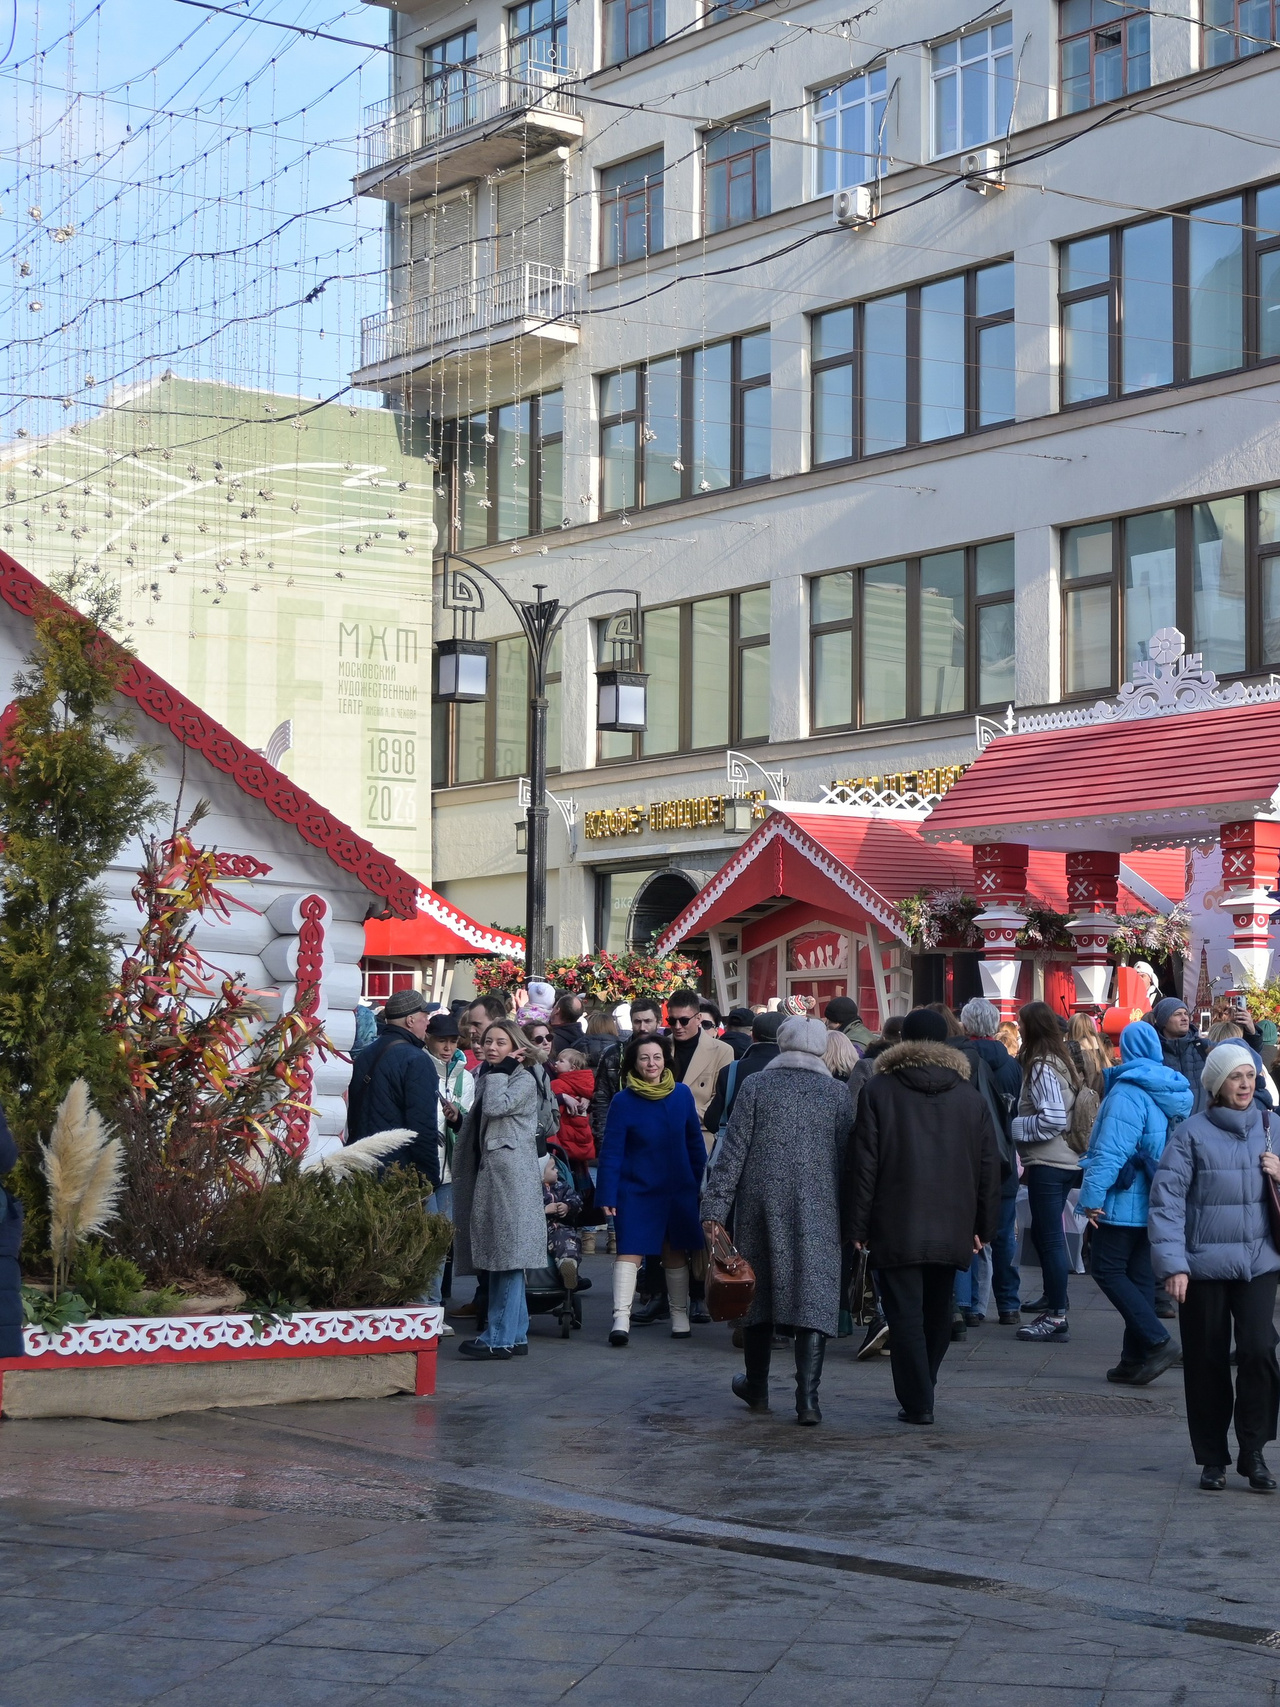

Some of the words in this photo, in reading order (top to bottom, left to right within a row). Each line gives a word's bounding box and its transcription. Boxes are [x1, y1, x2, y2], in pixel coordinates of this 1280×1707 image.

[338, 661, 396, 681] МОСКОВСКИЙ
[338, 680, 417, 701] ХУДОЖЕСТВЕННЫЙ
[338, 698, 363, 715] ТЕАТР
[367, 737, 415, 775] 1898
[830, 762, 974, 807] АКАДЕМИ
[368, 785, 416, 823] 2023
[584, 789, 766, 840] КАФЕ-ПИЦЦЕЯ
